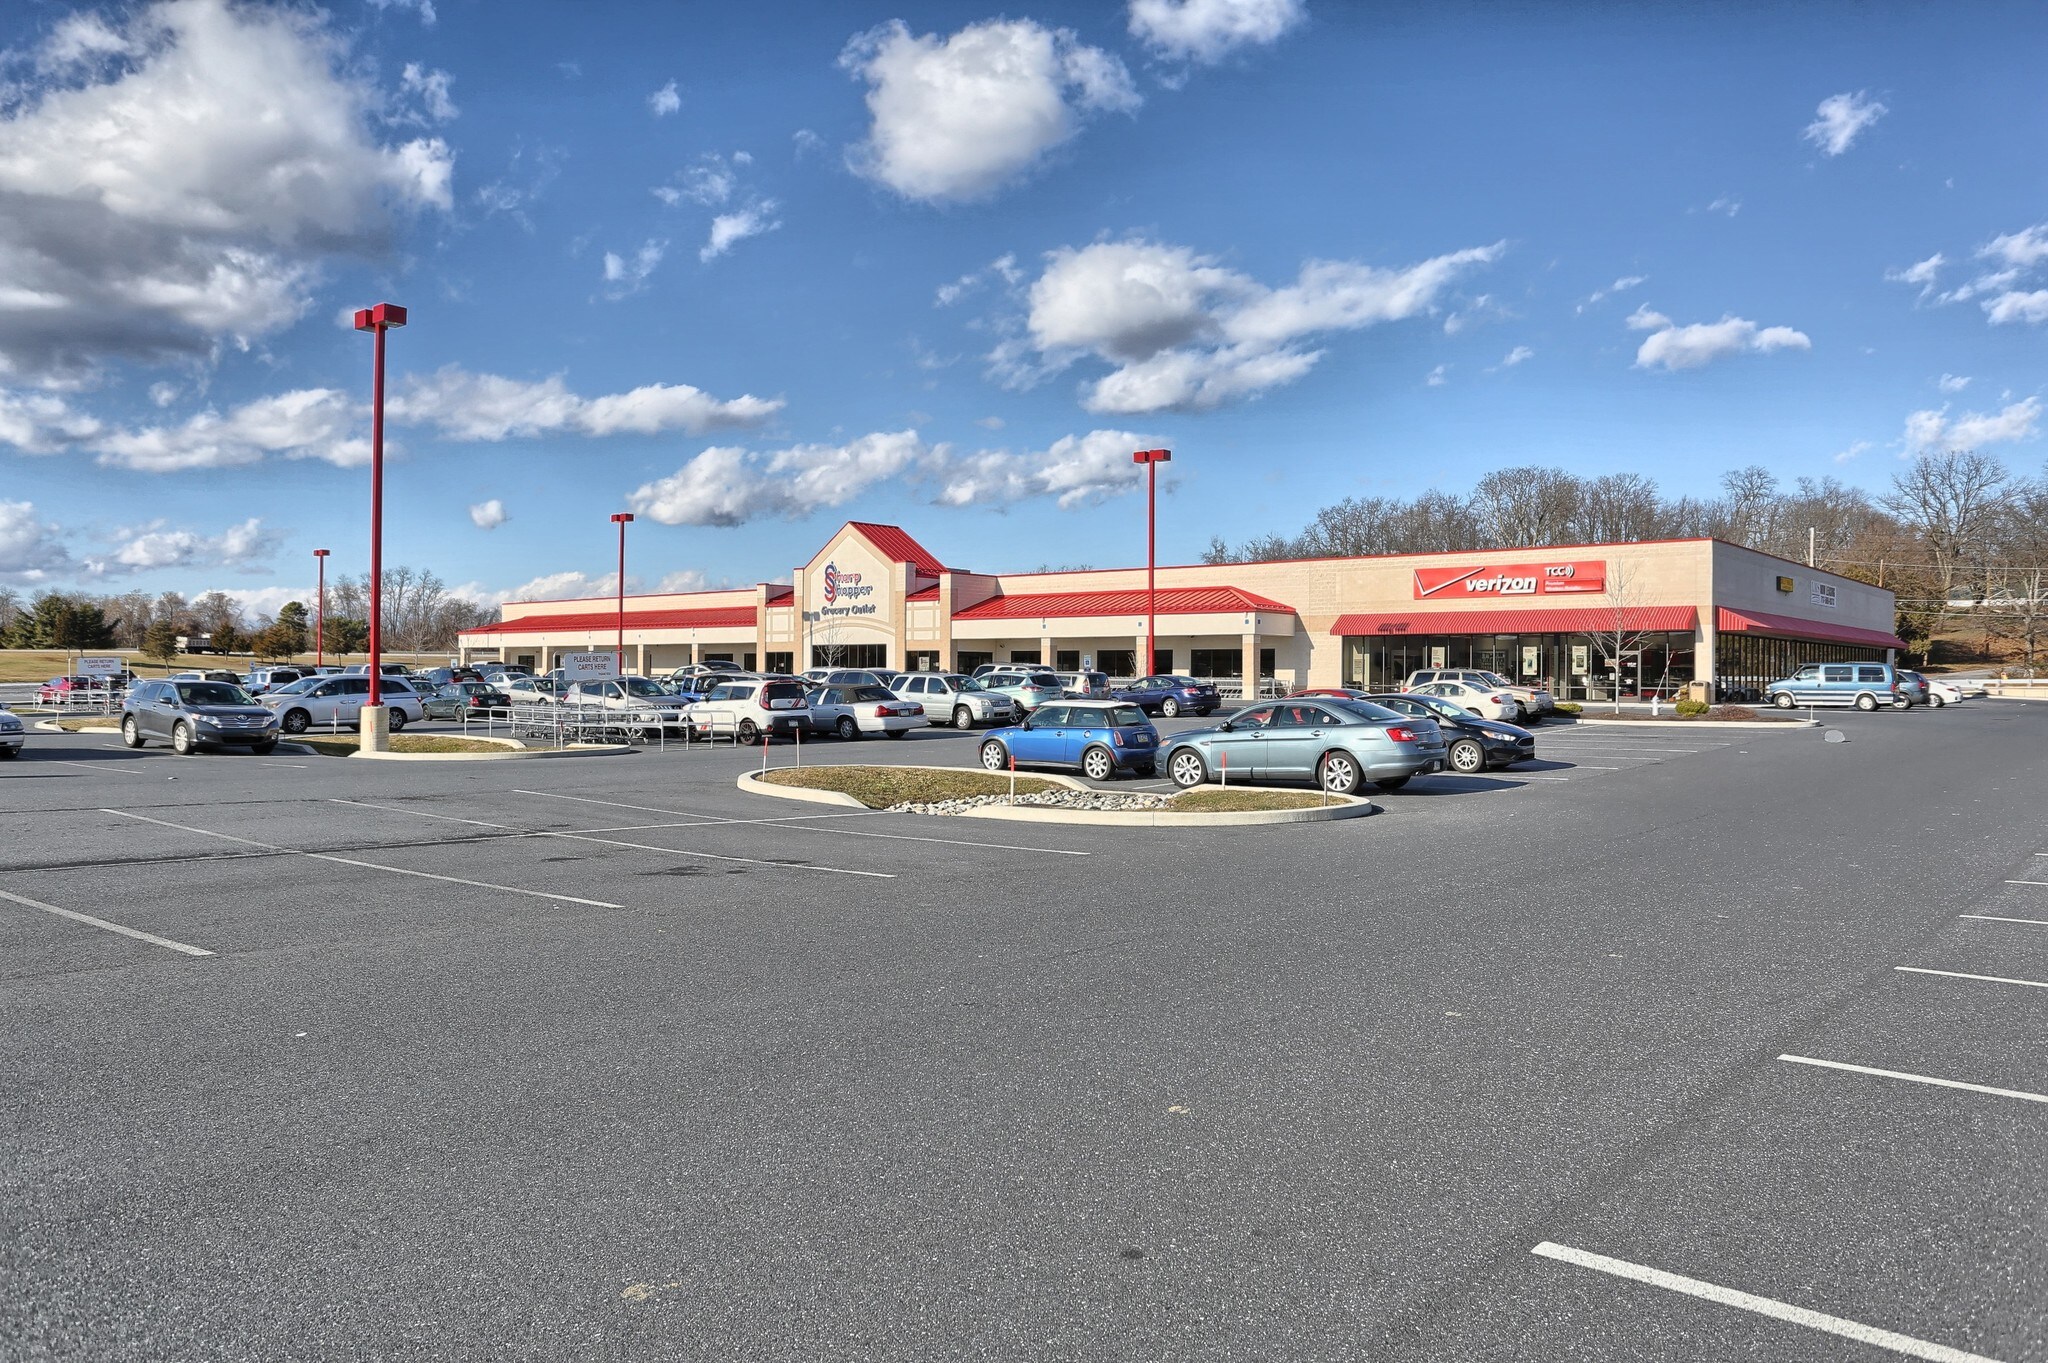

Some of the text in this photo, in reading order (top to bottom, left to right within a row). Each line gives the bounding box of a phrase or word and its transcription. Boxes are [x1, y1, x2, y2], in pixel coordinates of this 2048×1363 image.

[1544, 566, 1566, 576] TCC
[1466, 575, 1536, 594] verizon
[821, 604, 876, 616] Grocery Outlet
